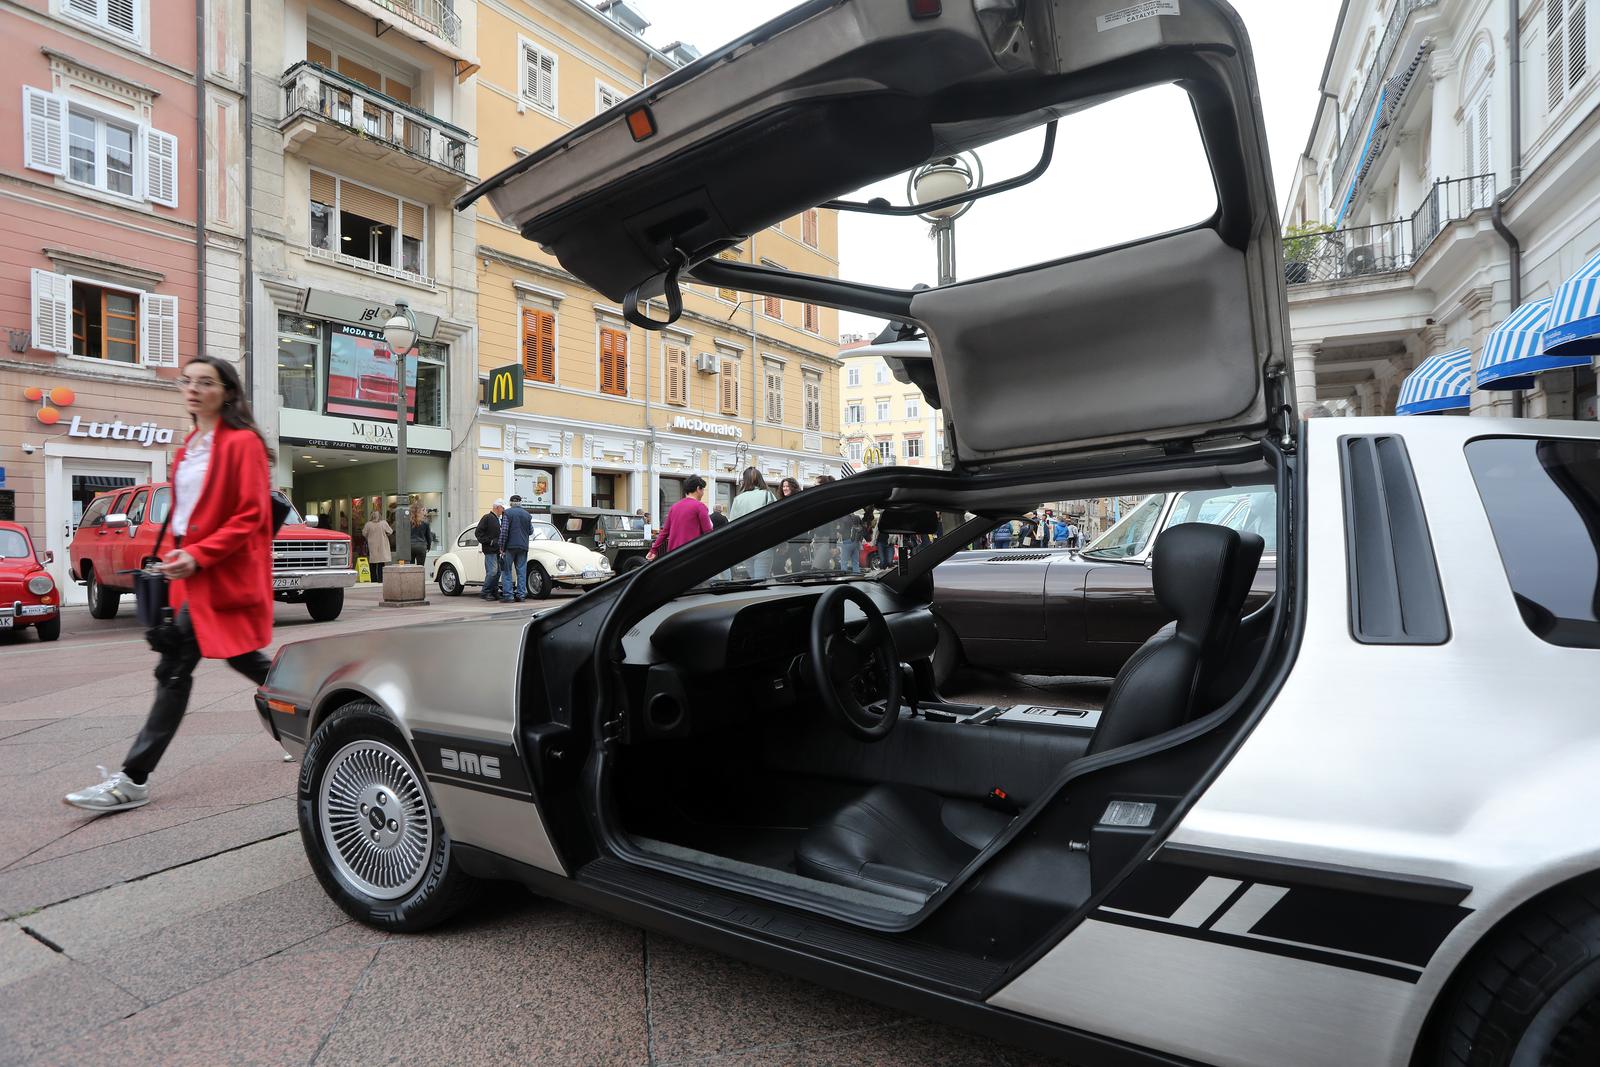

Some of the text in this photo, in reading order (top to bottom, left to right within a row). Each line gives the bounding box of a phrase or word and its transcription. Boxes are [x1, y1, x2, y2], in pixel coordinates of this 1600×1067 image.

[1126, 9, 1158, 22] CATALYST
[359, 307, 381, 321] jgl
[342, 326, 366, 337] MODA
[68, 415, 174, 447] Lutrija
[672, 415, 743, 438] McDonald's
